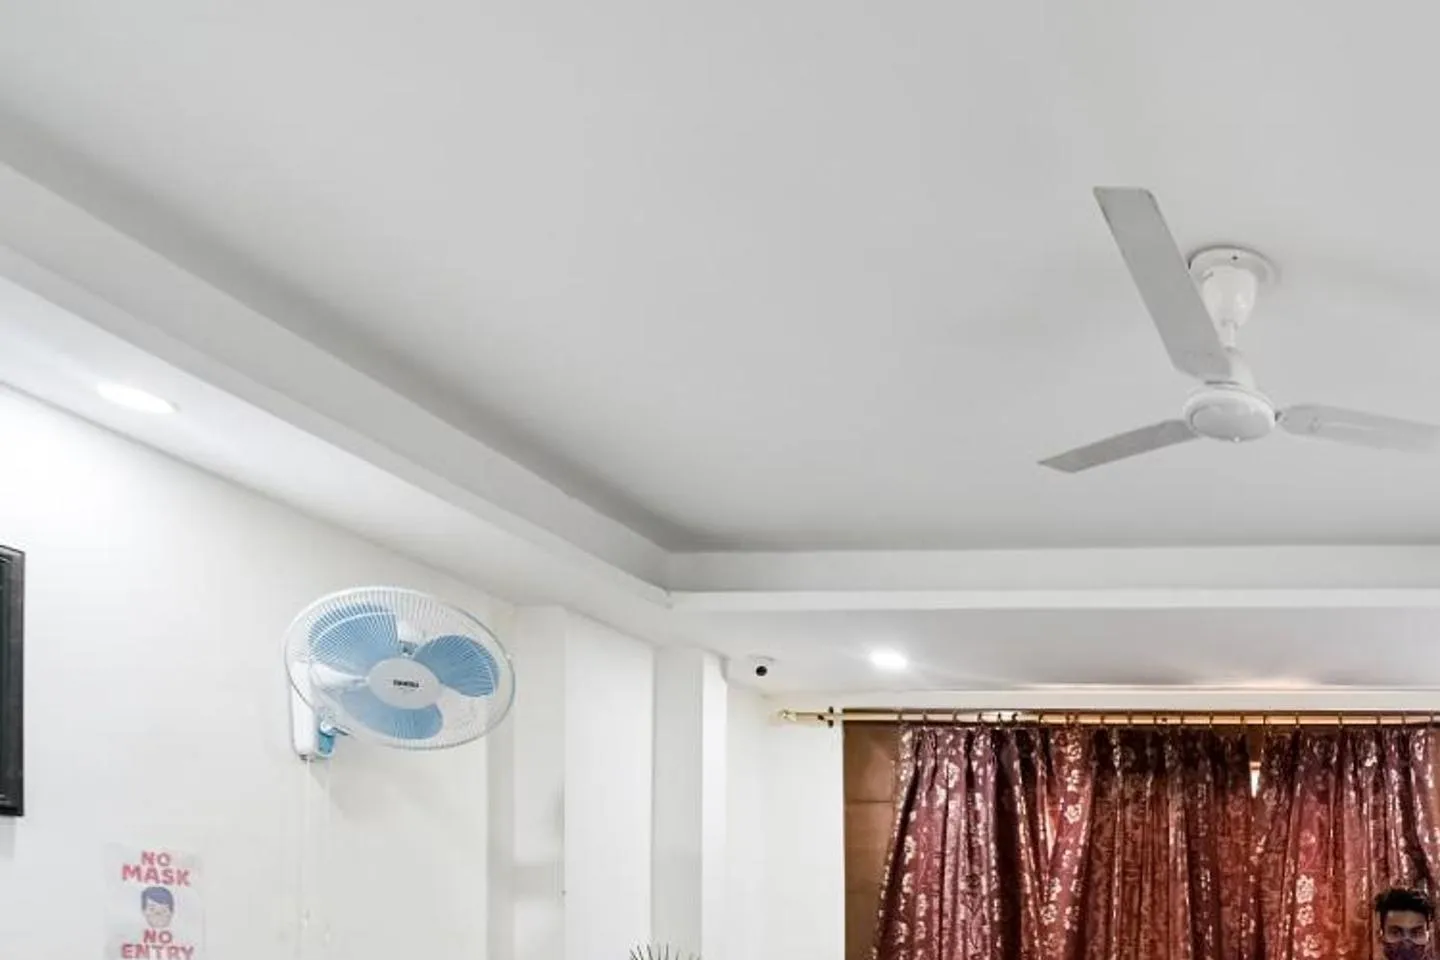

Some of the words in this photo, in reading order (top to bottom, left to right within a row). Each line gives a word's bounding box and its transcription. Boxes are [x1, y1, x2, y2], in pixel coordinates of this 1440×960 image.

[142, 852, 170, 866] NO
[122, 864, 191, 886] MASK
[143, 929, 173, 944] NO
[121, 944, 193, 960] ENTRY
